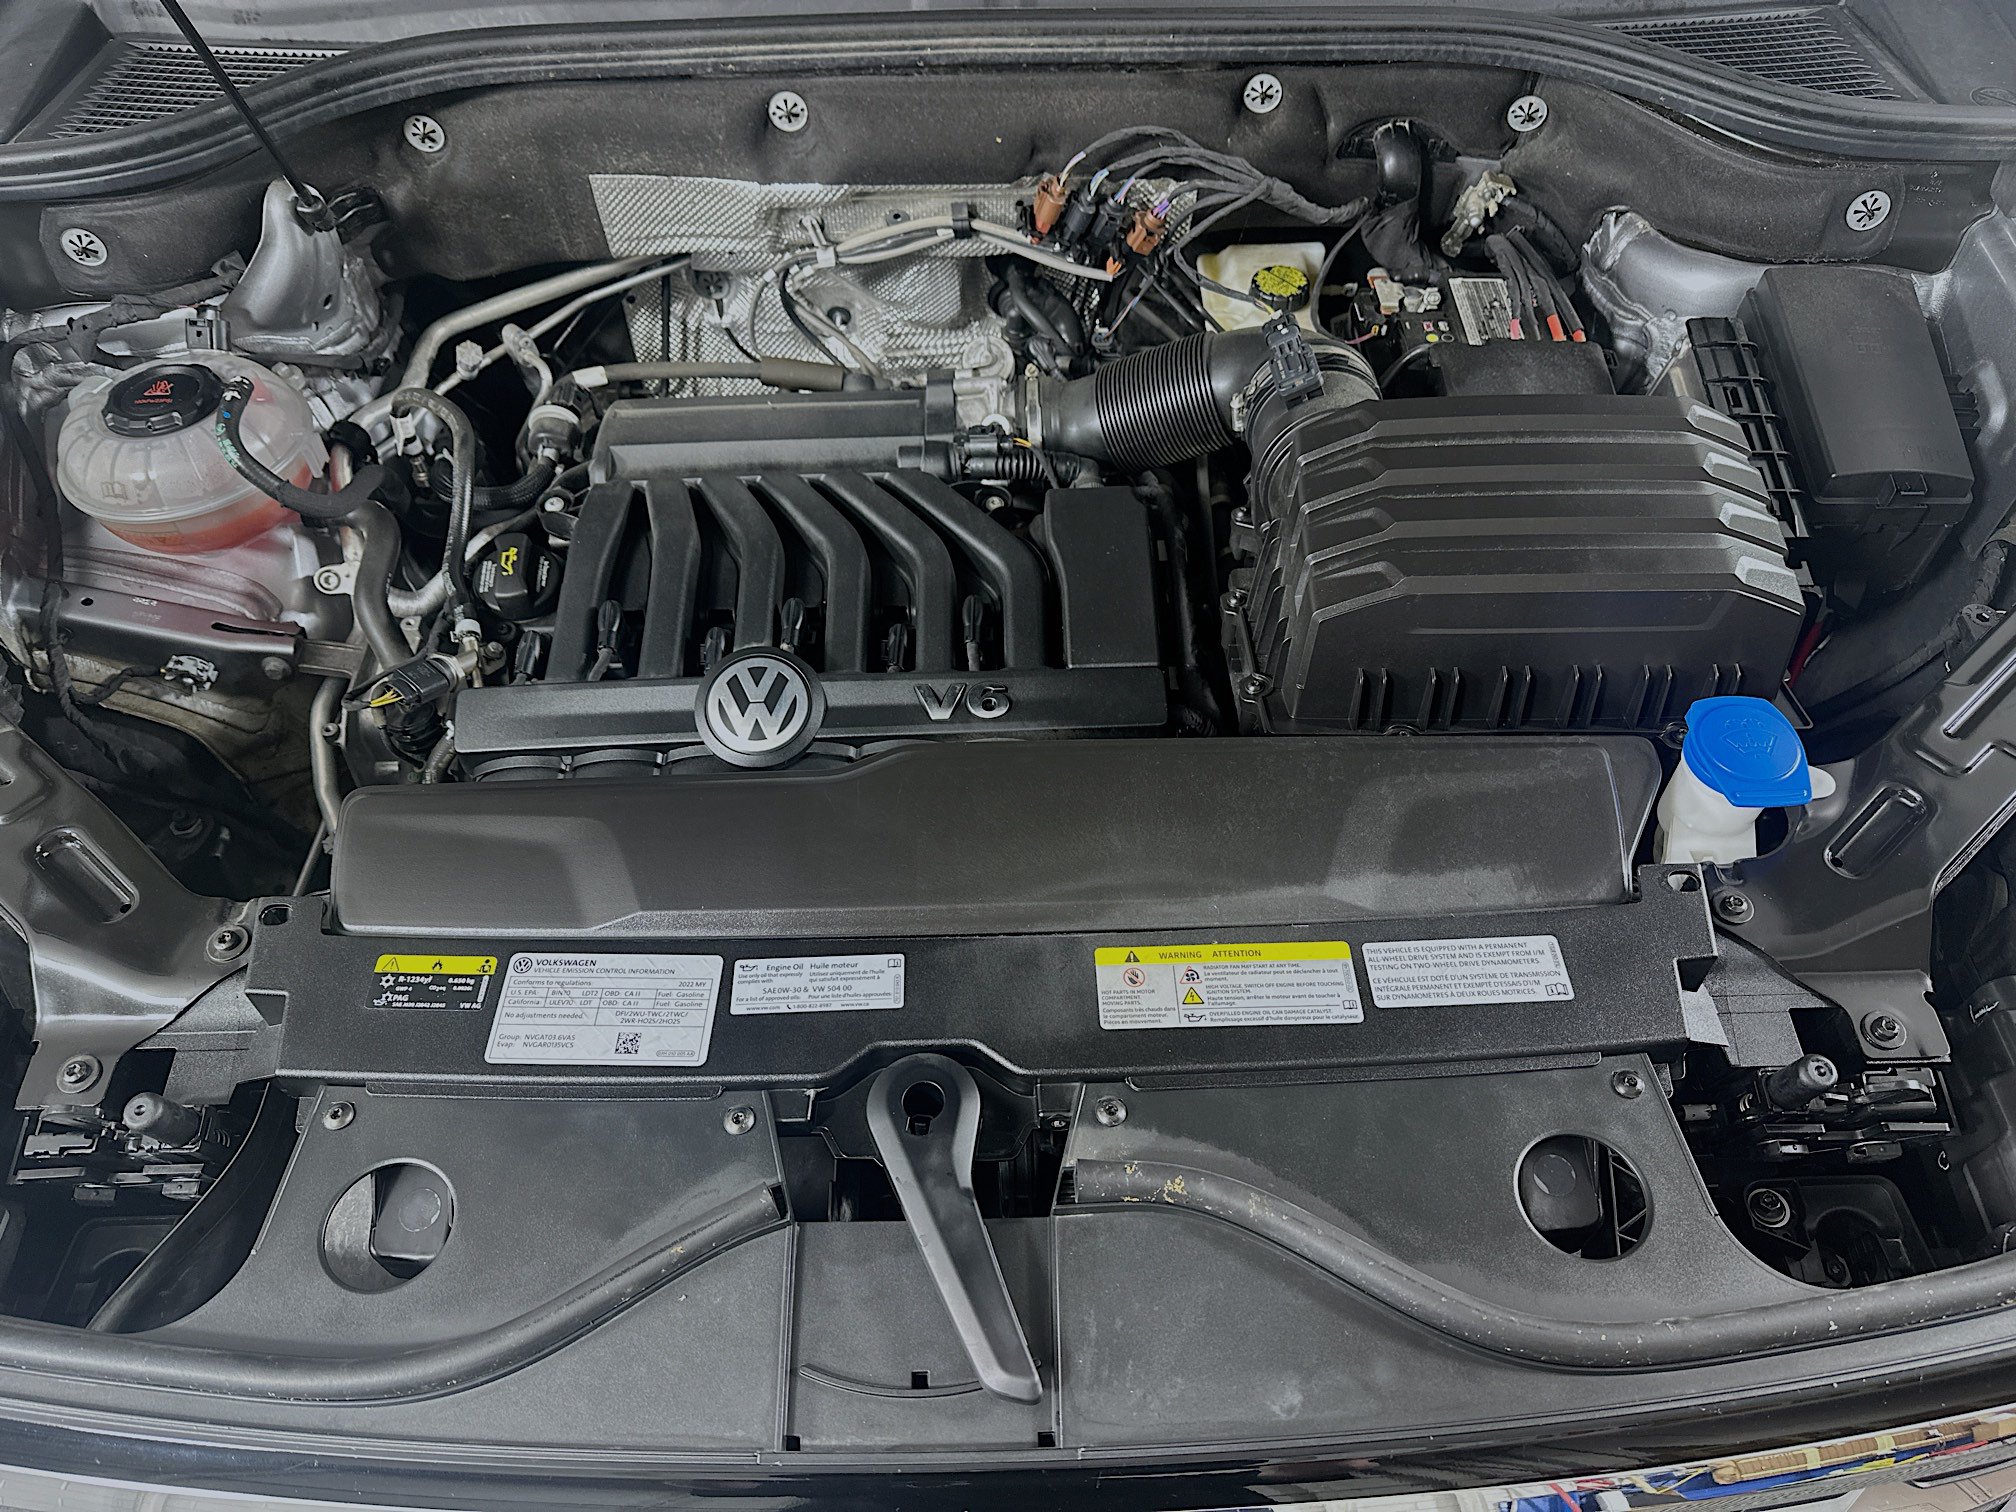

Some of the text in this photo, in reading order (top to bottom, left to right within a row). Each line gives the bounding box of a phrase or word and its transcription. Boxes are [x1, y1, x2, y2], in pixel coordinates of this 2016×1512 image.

[913, 682, 1010, 721] V6
[1421, 945, 1457, 953] EQUIPPED
[1485, 942, 1528, 950] PERMANENT
[1158, 949, 1262, 959] WARNING ATTENTION
[1368, 954, 1407, 962] ALL-WHEEL
[1430, 952, 1457, 960] SYSTEM
[1483, 950, 1510, 958] EXEMPT
[536, 959, 597, 967] VOLKSWAGEN
[766, 964, 792, 972] Engine
[1370, 963, 1400, 971] TESTING
[1412, 961, 1457, 969] TWO-WHEEL
[1509, 970, 1561, 978] TRANSMISSION
[515, 1012, 558, 1020] adjustments
